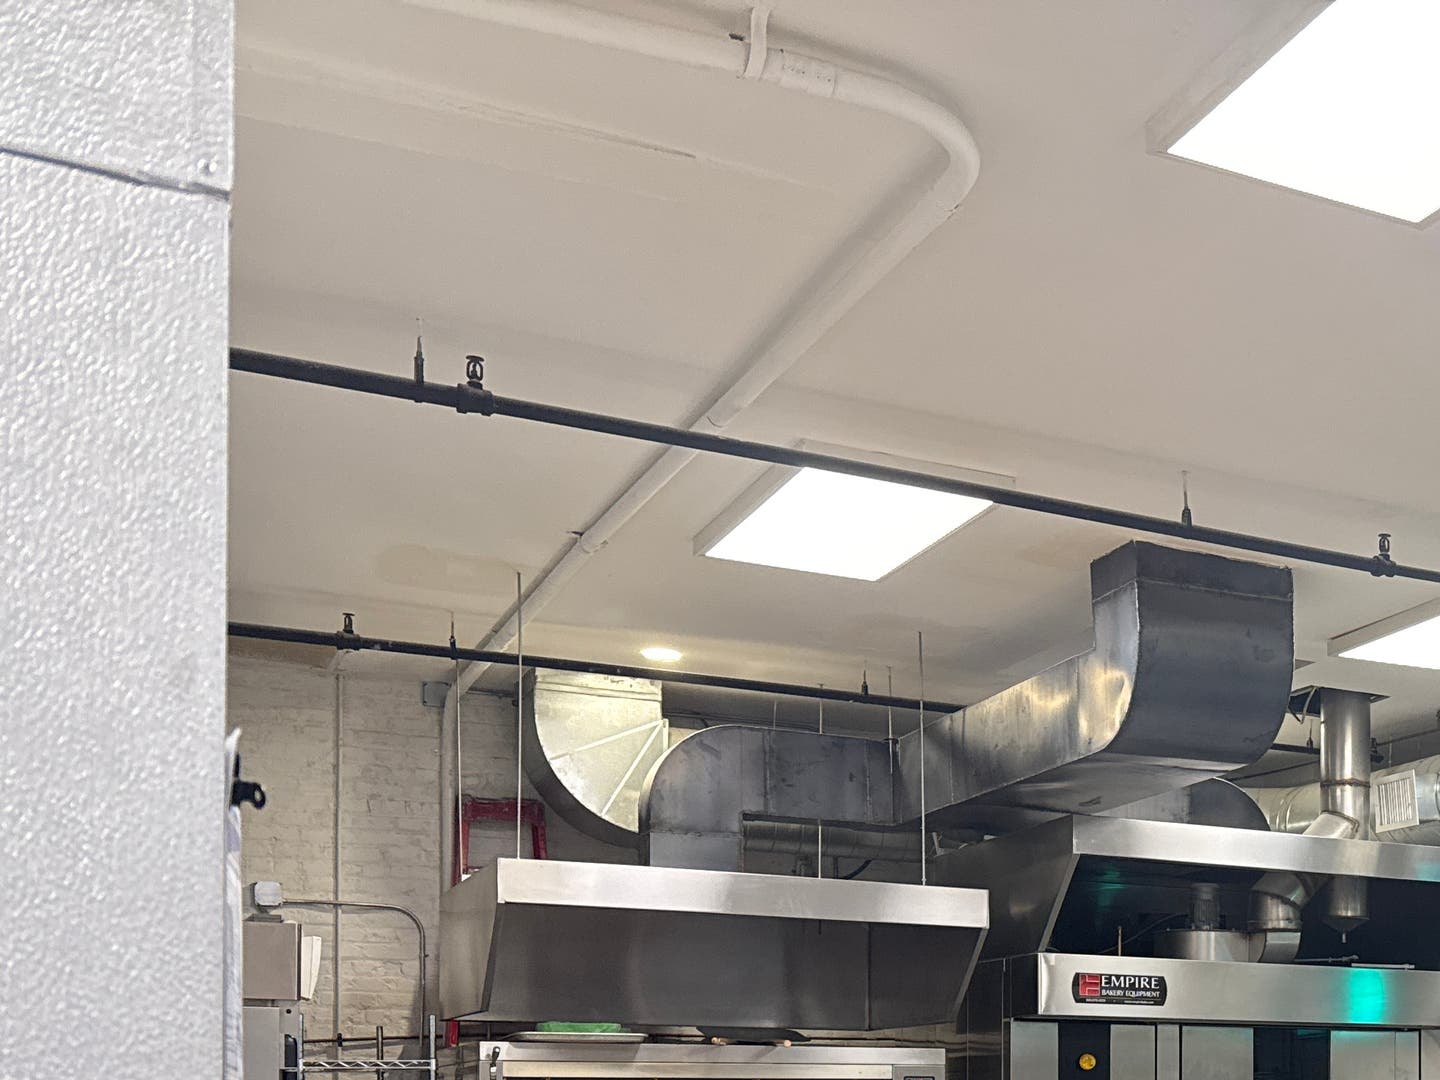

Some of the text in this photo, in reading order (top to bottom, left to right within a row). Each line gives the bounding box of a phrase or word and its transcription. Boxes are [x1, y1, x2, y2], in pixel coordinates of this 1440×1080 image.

[1101, 975, 1160, 989] EMPIRE
[1101, 989, 1160, 998] BAKERY EQUIPMENT
